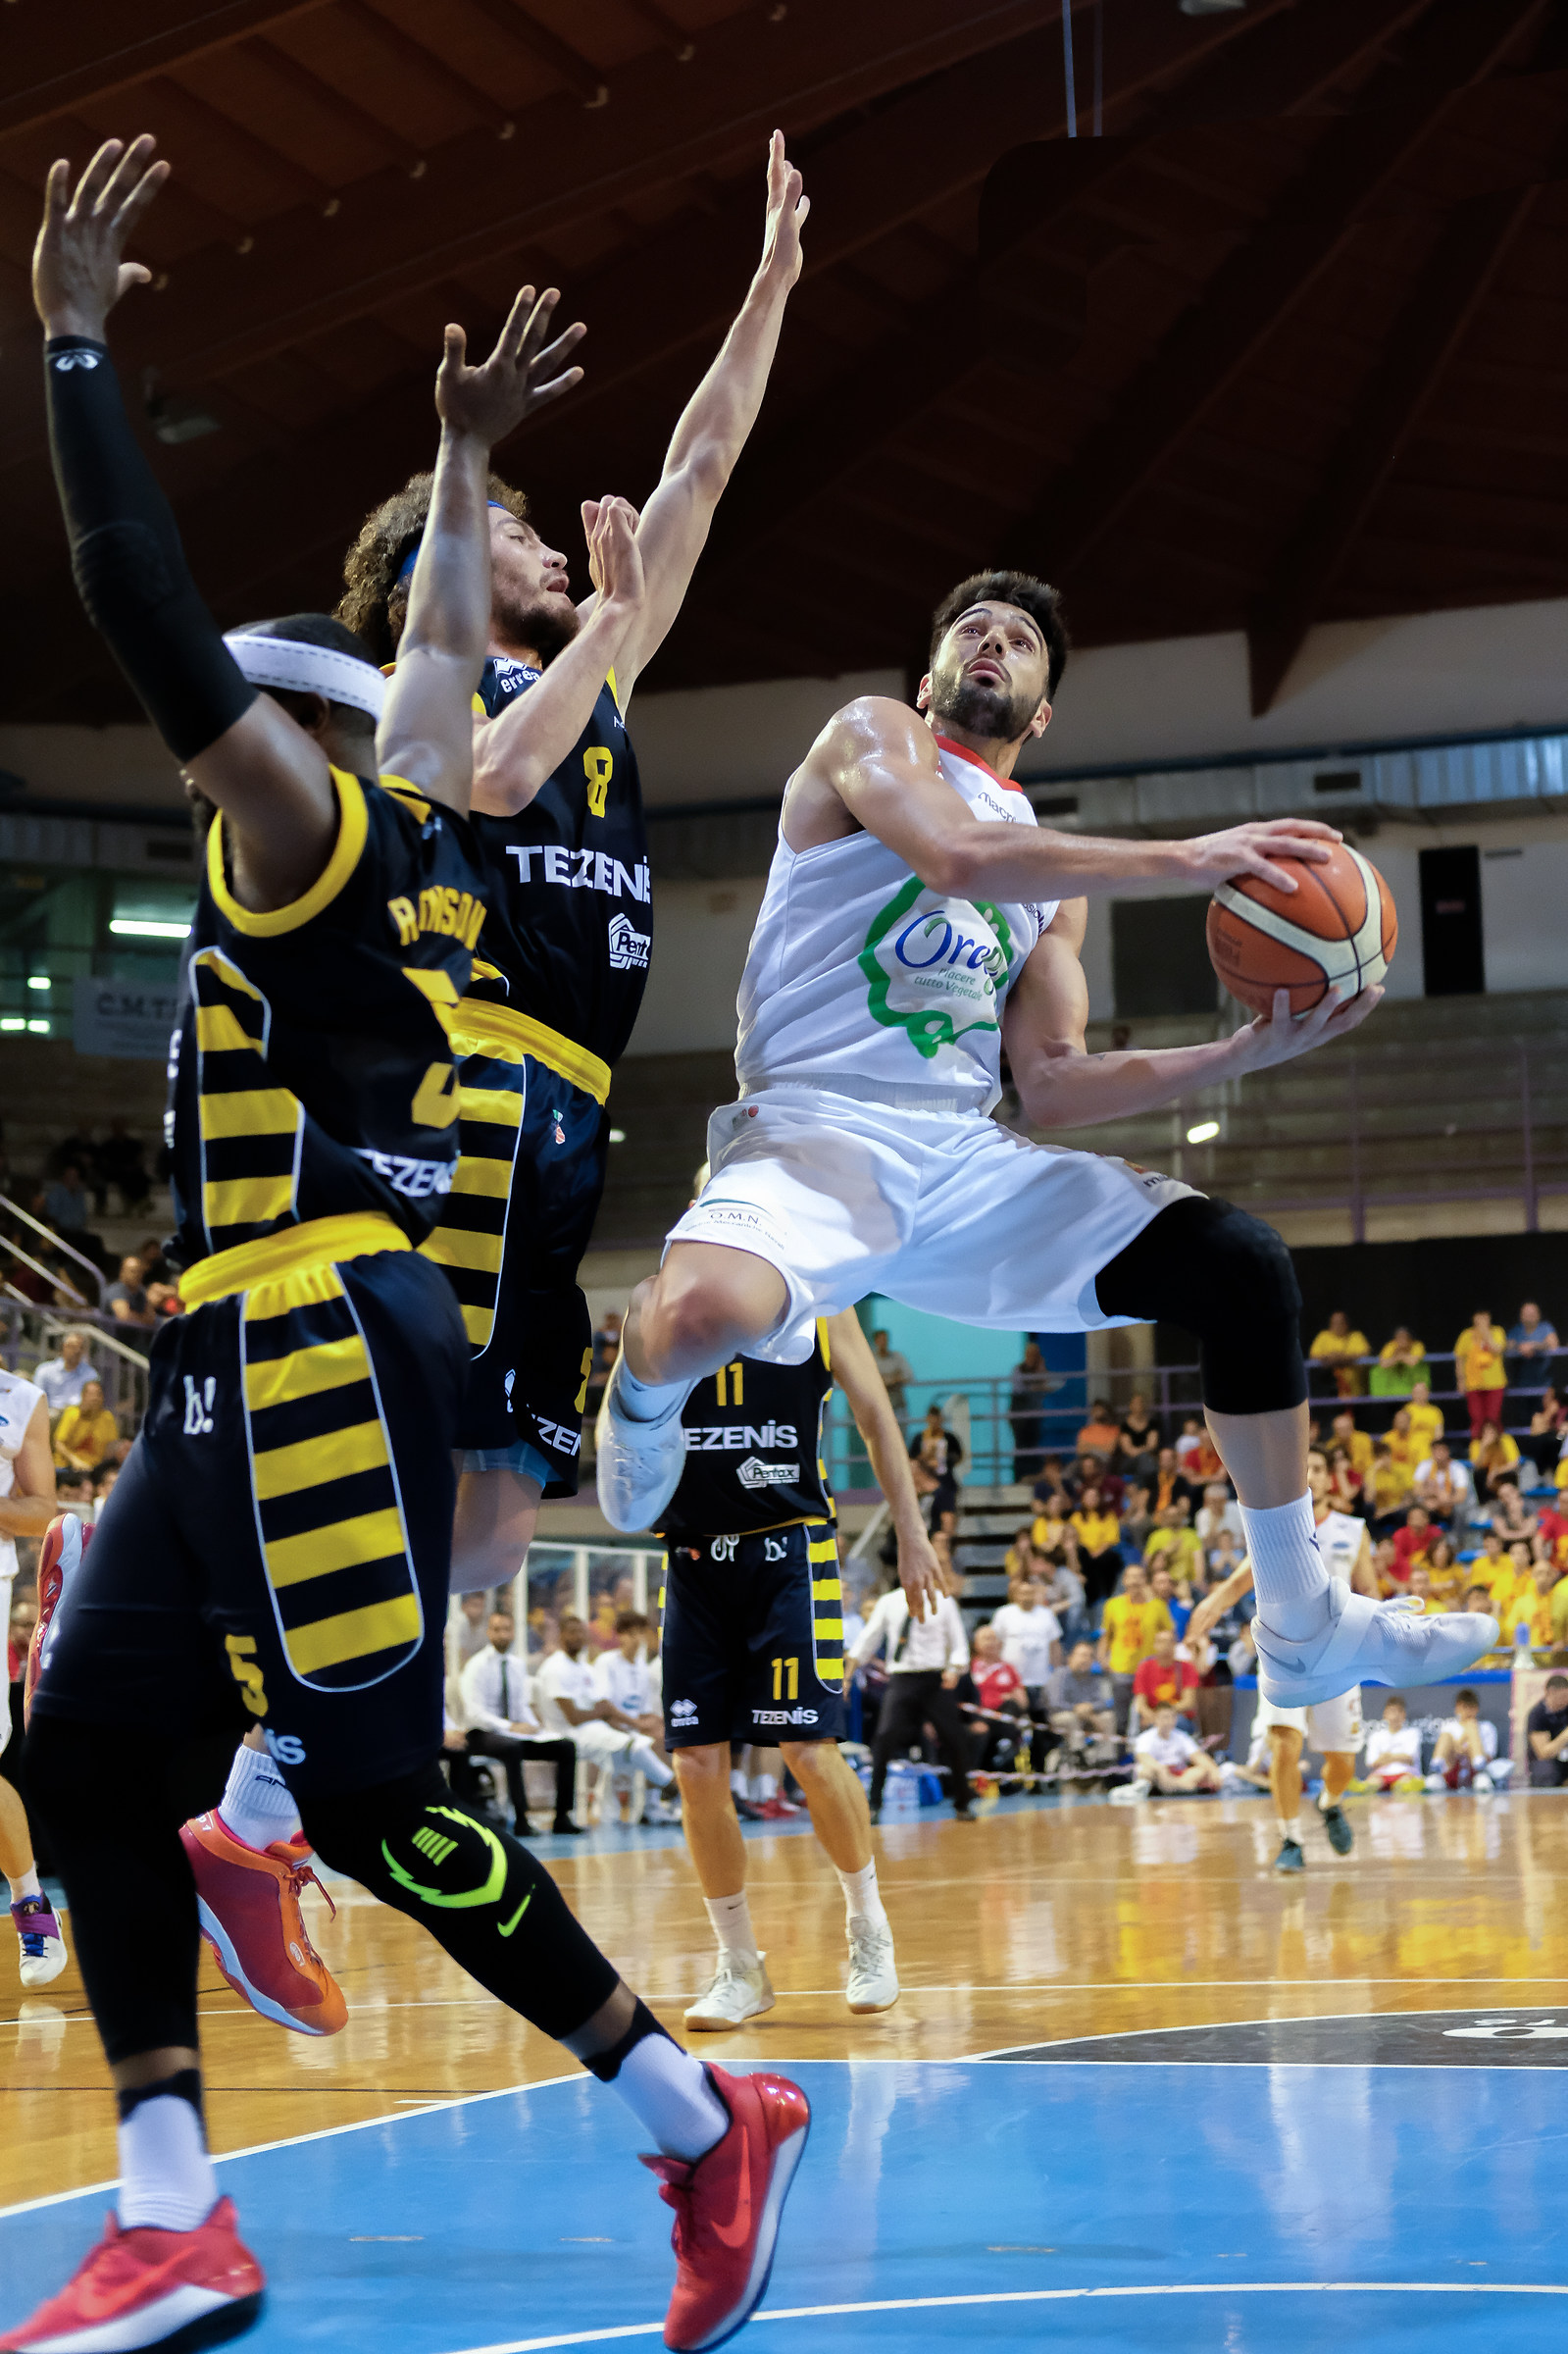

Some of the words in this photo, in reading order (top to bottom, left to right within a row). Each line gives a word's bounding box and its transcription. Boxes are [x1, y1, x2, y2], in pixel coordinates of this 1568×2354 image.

[582, 746, 614, 818] 8
[716, 1361, 743, 1407] 11
[683, 1419, 799, 1451] EZENIS
[772, 1658, 799, 1701] 11
